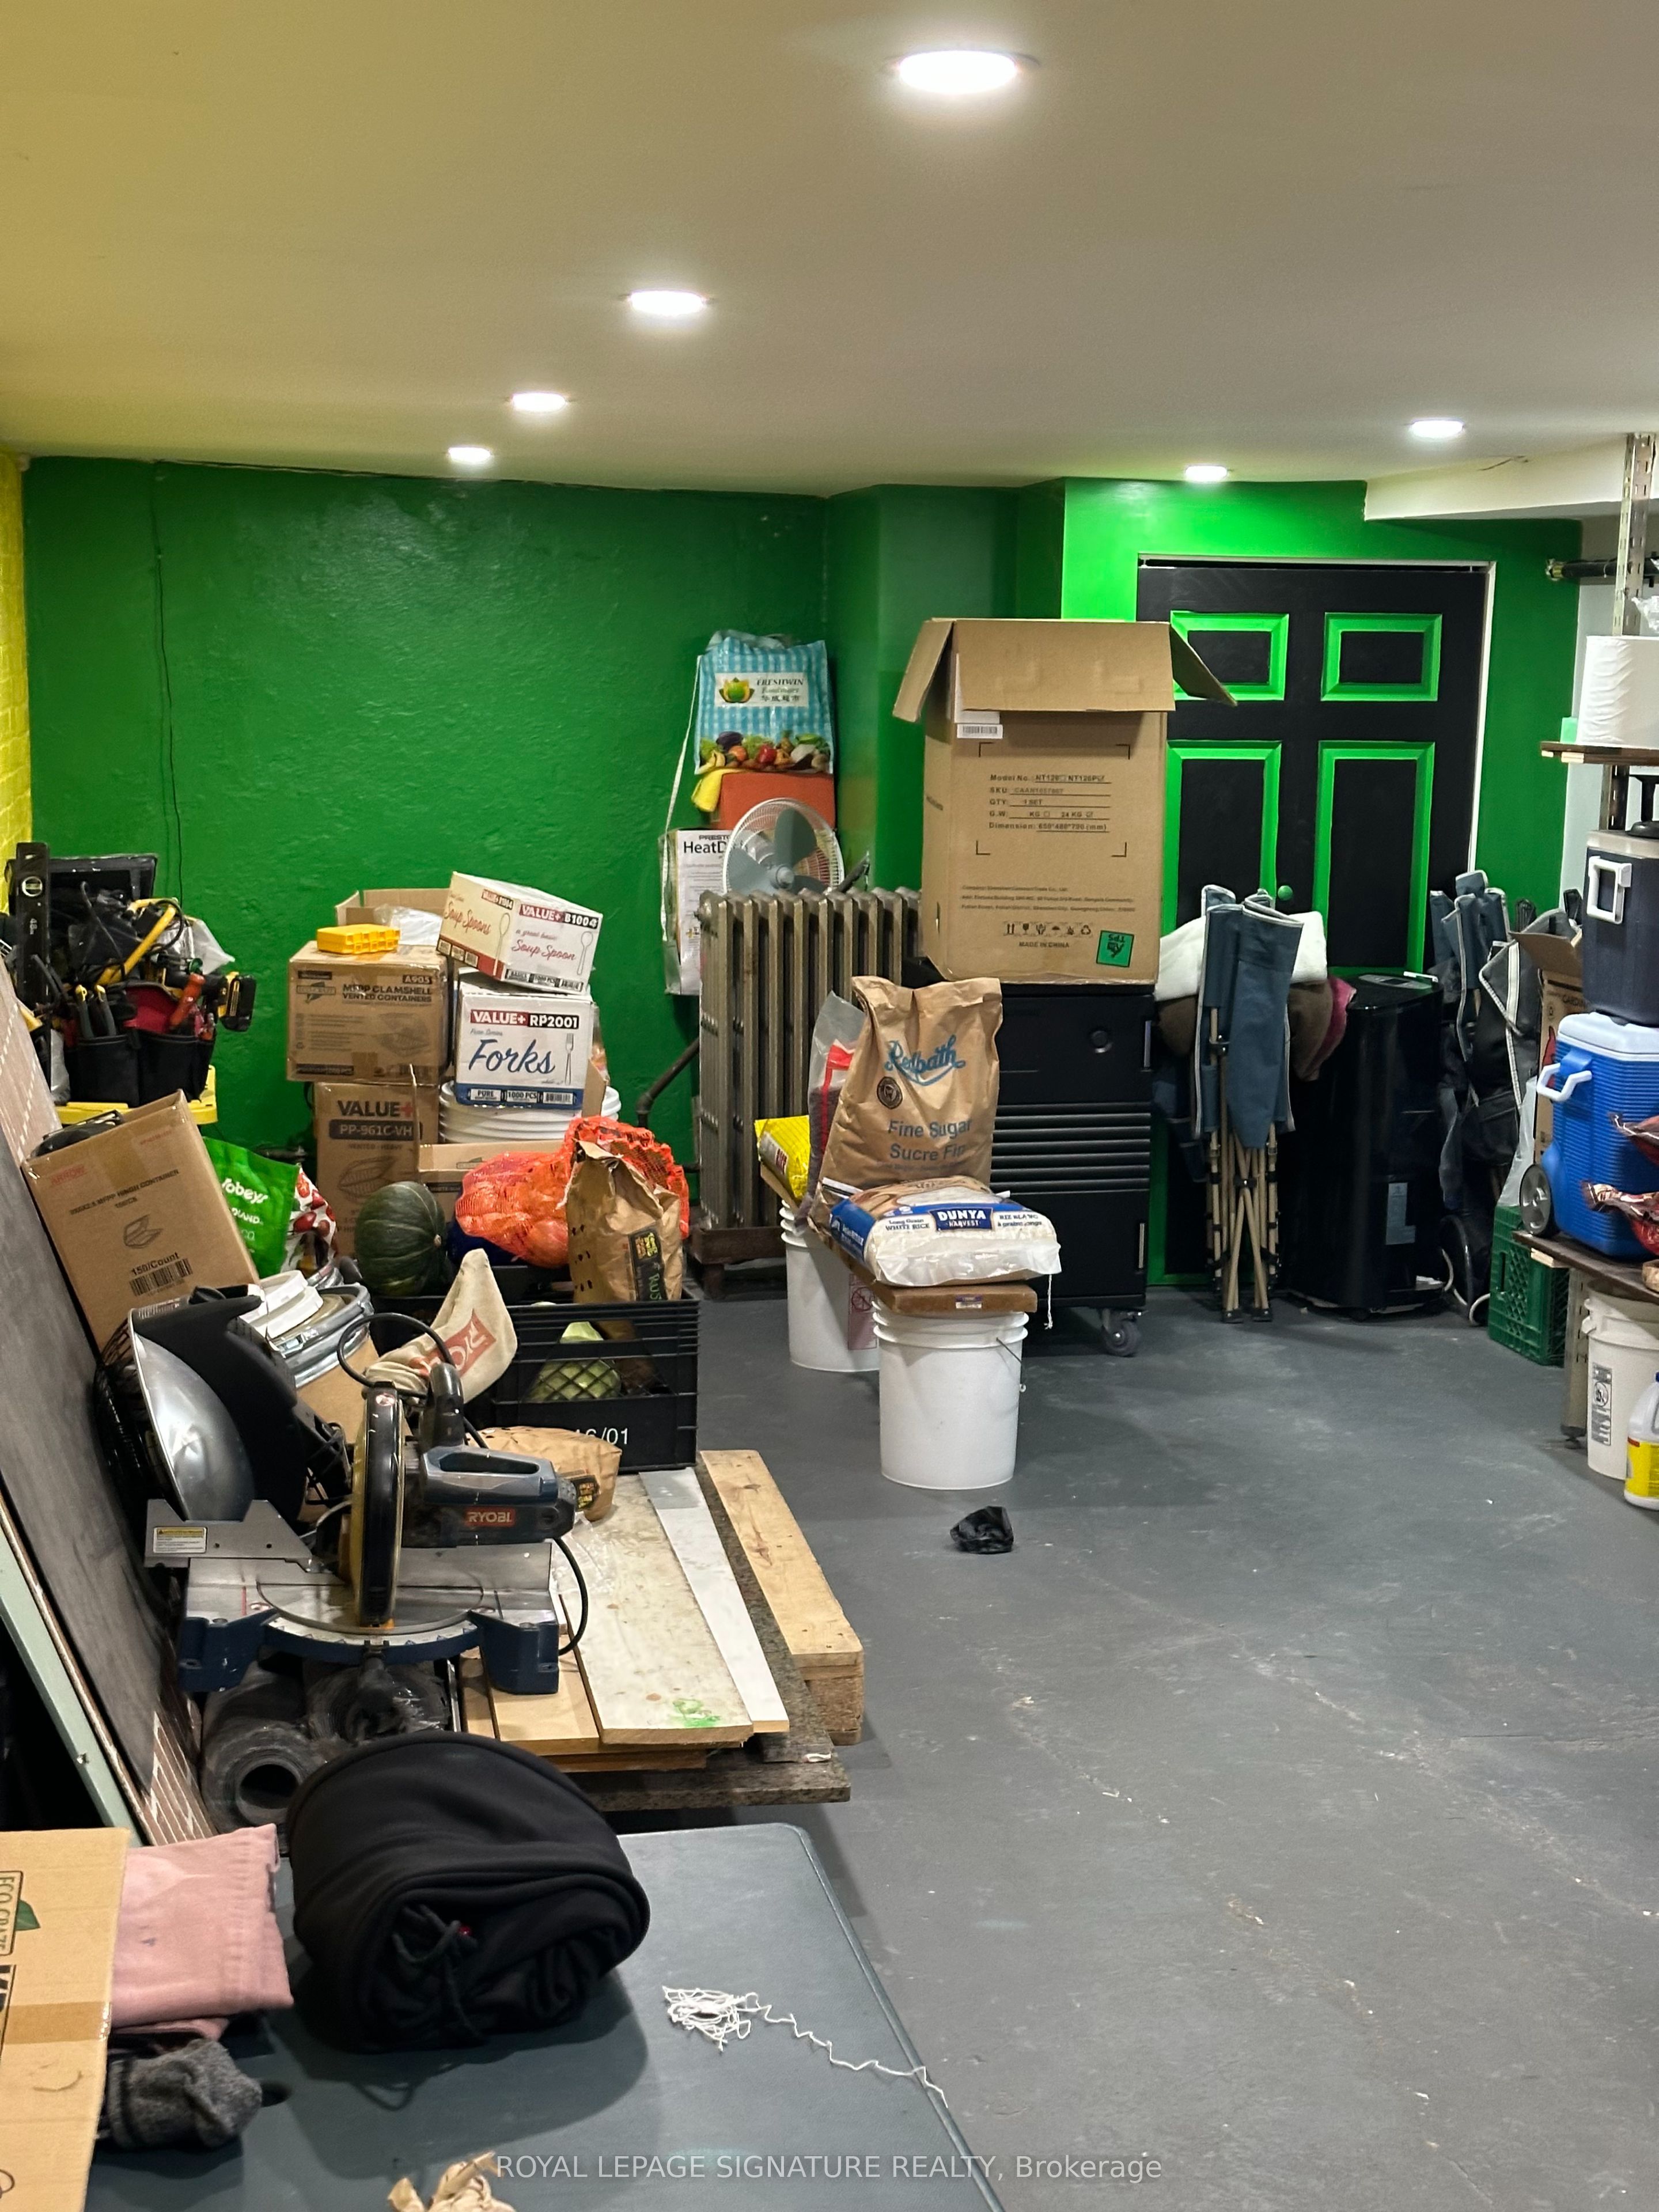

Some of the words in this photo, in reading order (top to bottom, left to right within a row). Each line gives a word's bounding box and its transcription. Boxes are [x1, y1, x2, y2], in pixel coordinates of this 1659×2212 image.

[444, 901, 463, 929] Soup
[463, 909, 491, 935] Spoons
[521, 906, 562, 922] VALUE+
[564, 912, 597, 929] B1004
[511, 939, 541, 957] Soup
[541, 945, 576, 961] Spoon
[374, 986, 432, 995] CLAMSHELL
[377, 994, 432, 1002] CONTAINERS
[472, 1010, 527, 1024] VALUE+
[529, 1014, 578, 1028] RP2001
[468, 1039, 555, 1074] Forks
[884, 1034, 966, 1083] Redpath
[337, 1100, 414, 1117] VALUE+
[888, 1120, 924, 1137] Fine
[929, 1119, 972, 1139] Sugar
[889, 1142, 938, 1161] Sucre
[937, 1210, 986, 1221] DUNYA
[948, 1219, 979, 1228] HARVEST
[131, 1252, 180, 1276] 150/Count
[467, 1511, 512, 1522] RYOBI
